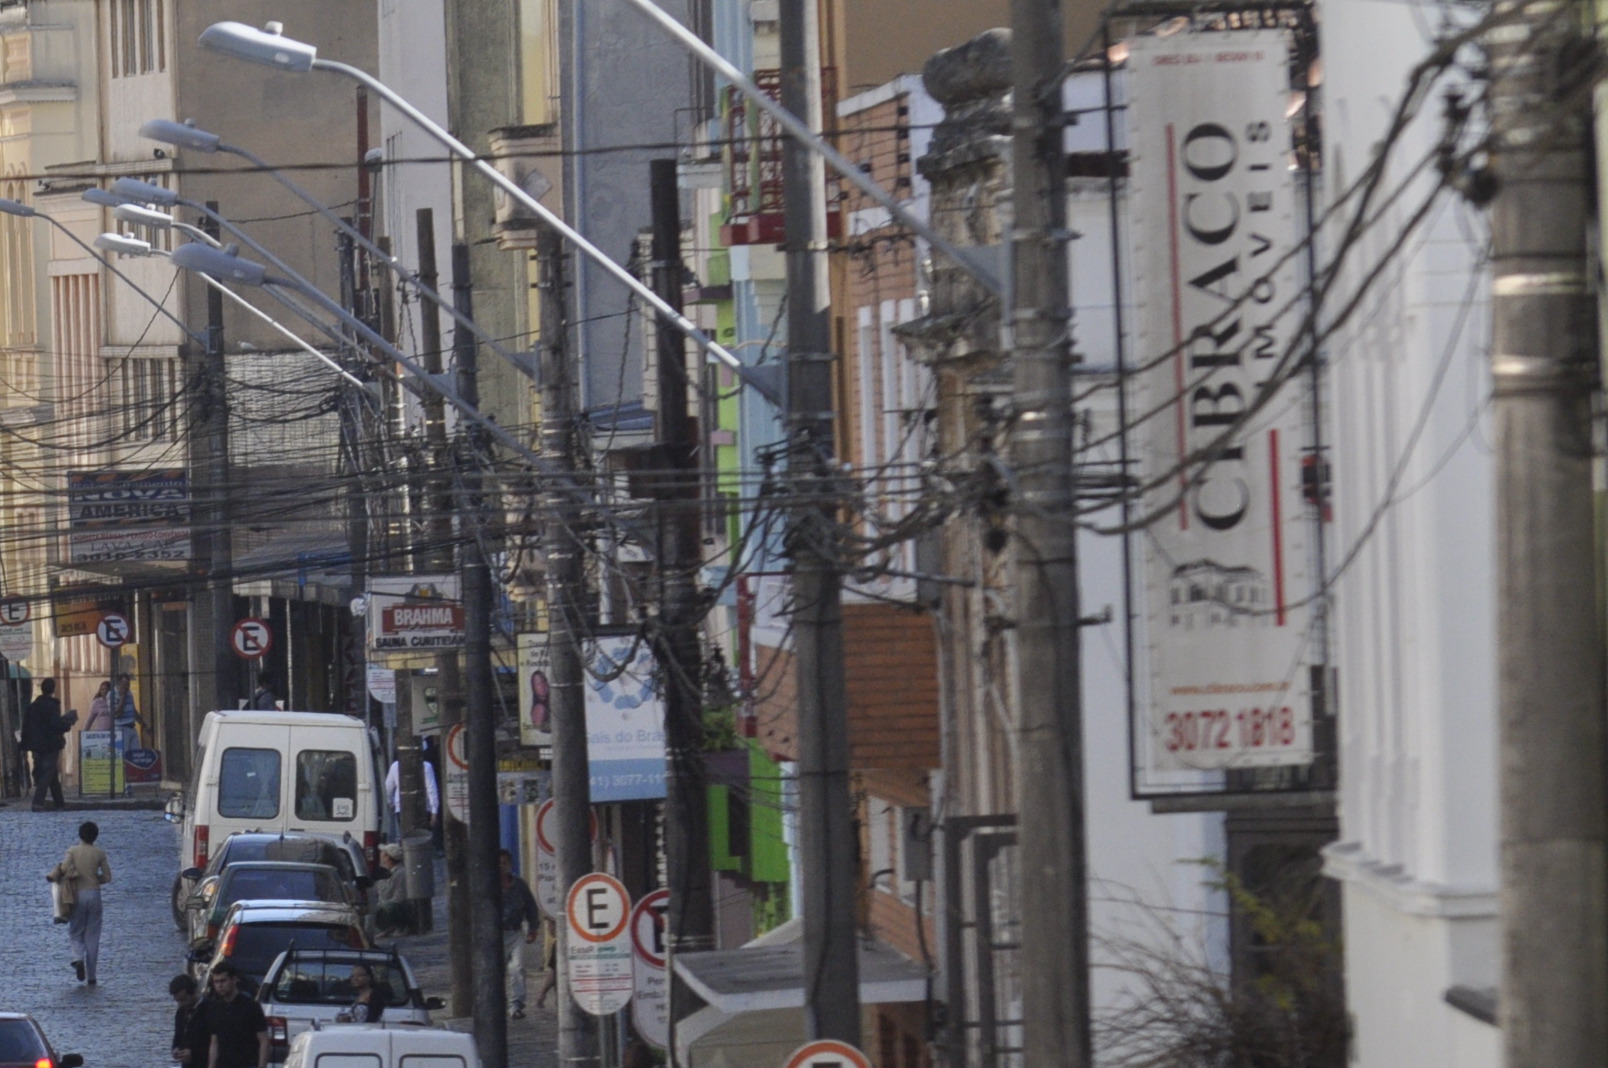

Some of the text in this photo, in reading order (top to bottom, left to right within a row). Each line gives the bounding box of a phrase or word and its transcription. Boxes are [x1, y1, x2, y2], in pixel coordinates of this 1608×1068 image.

[8, 601, 19, 620] E
[394, 608, 453, 625] BRAHMA
[1165, 705, 1296, 752] 3072 1818
[586, 888, 609, 929] E
